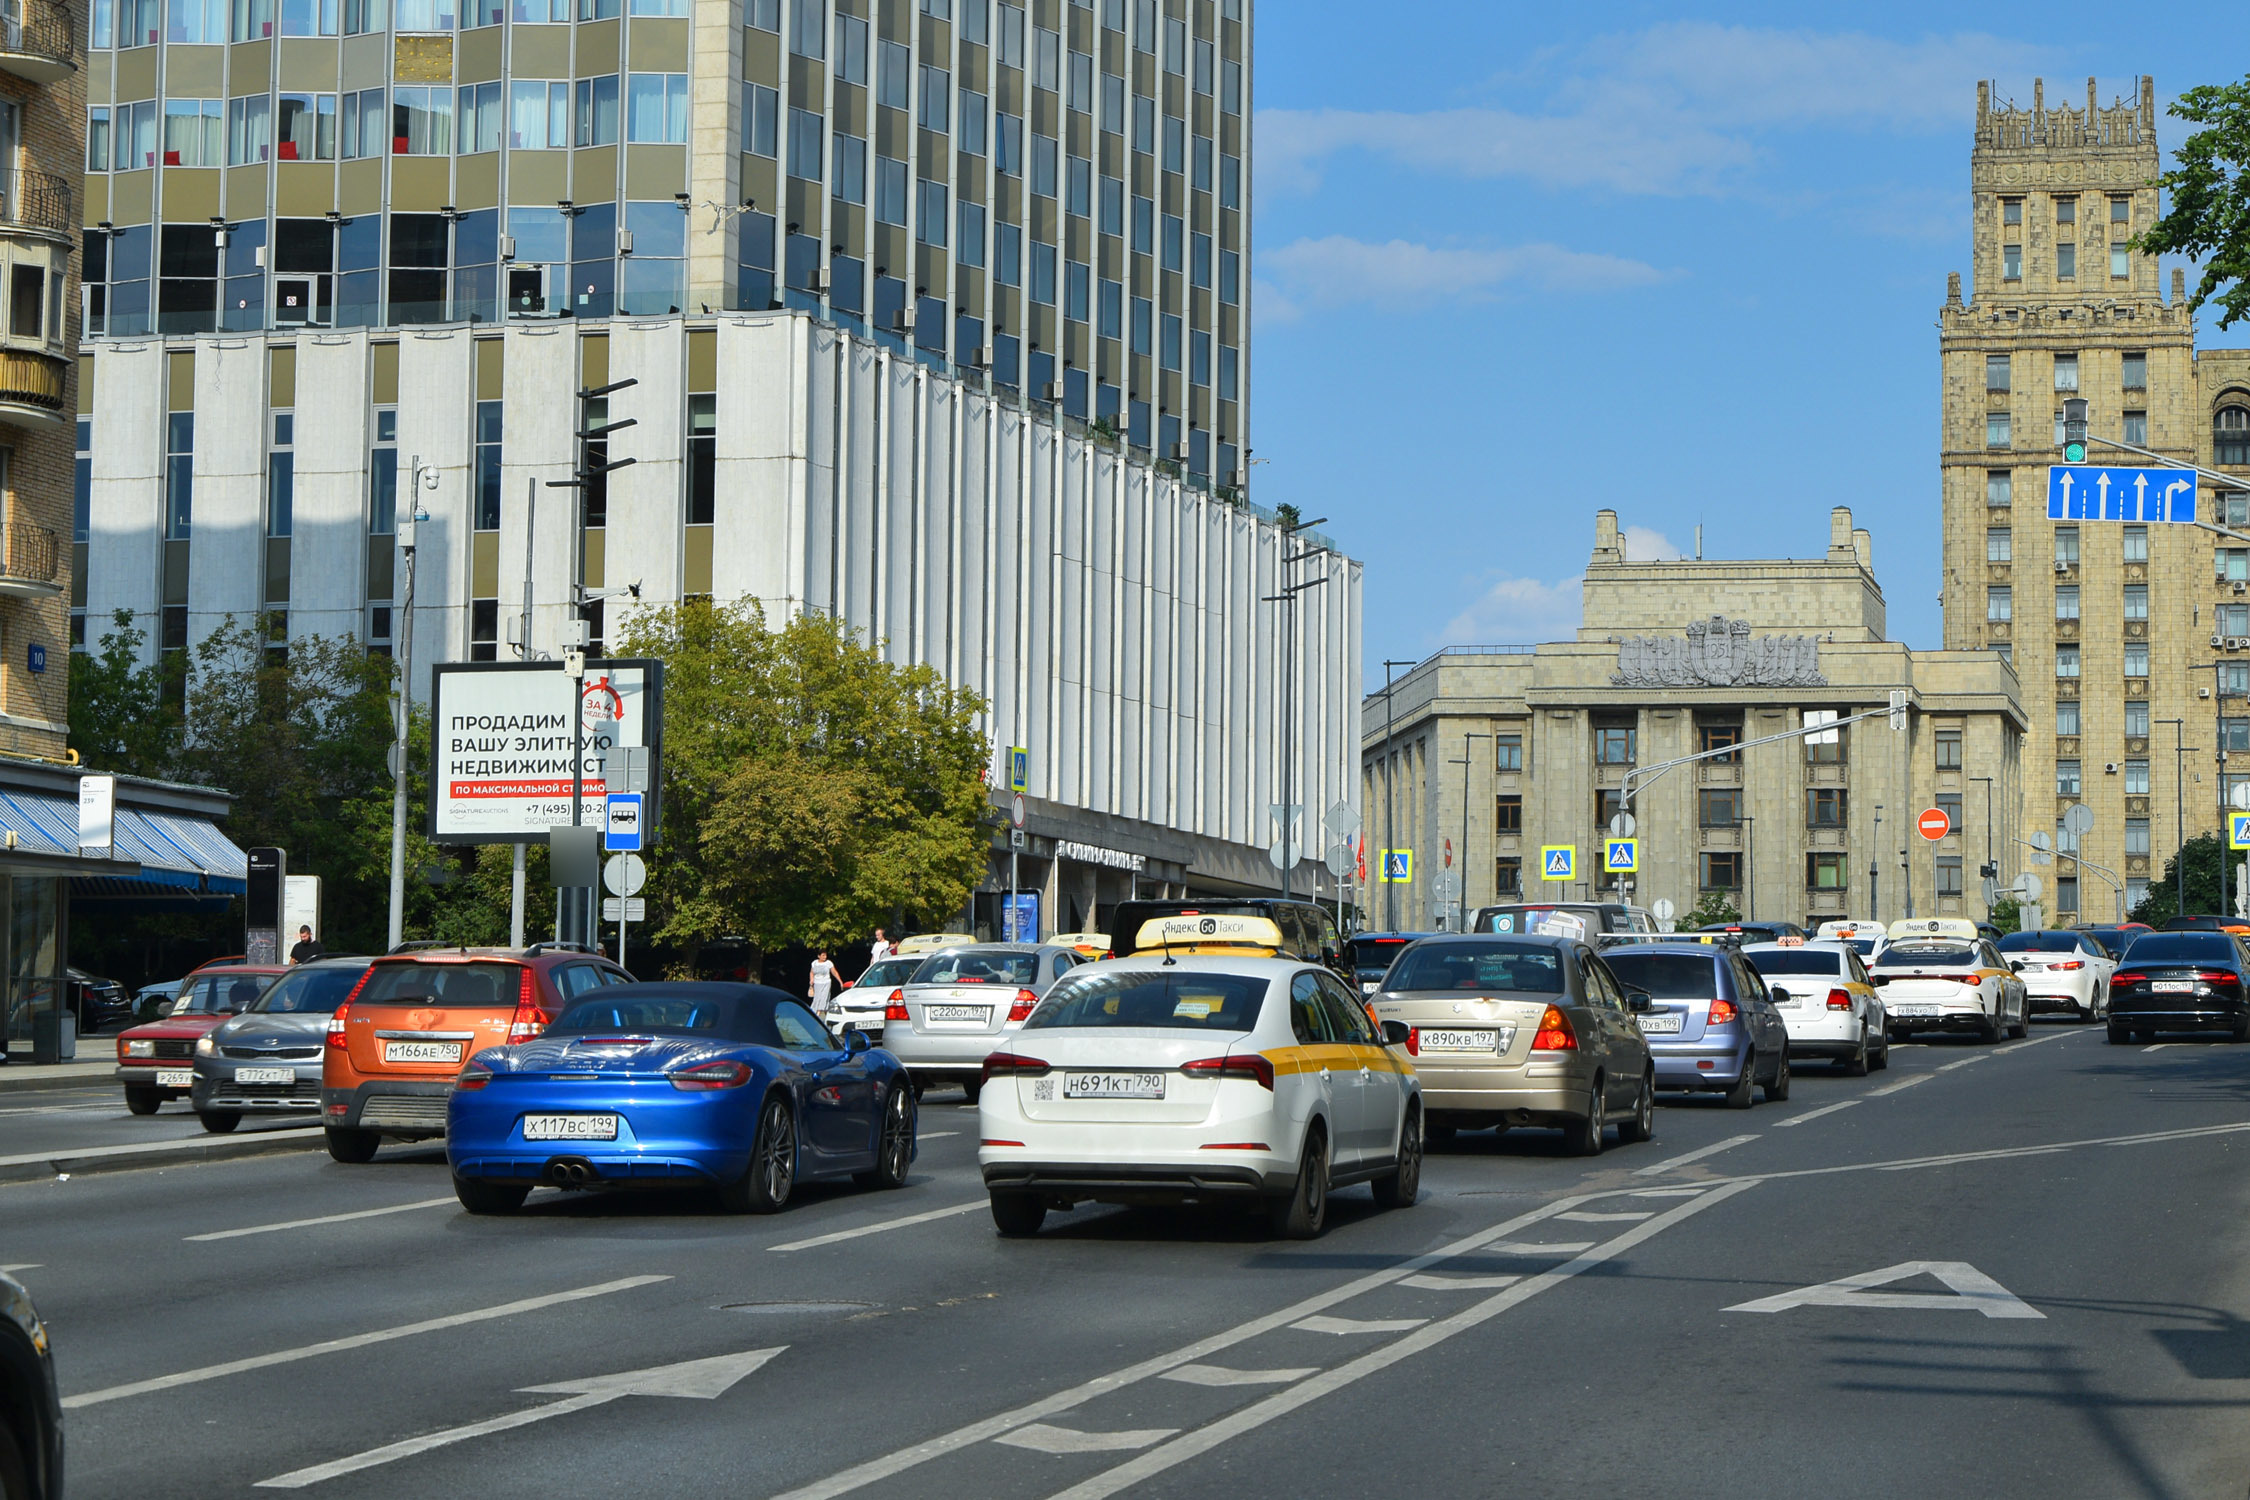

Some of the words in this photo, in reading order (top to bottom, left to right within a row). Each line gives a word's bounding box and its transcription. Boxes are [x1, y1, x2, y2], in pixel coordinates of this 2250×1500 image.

[1705, 643, 1730, 658] 1951
[34, 652, 44, 665] 10
[586, 699, 601, 710] ЗА
[604, 703, 612, 712] 4
[584, 710, 611, 719] НЕДЕЛИ
[452, 714, 566, 732] ПРОДАДИМ
[451, 737, 509, 753] ВАШУ
[451, 758, 607, 777] НЕДВИЖИМСТ
[455, 786, 471, 794] ПО
[473, 783, 560, 794] МАКСИМАЛЬНОЙ
[526, 805, 539, 813] +7
[542, 804, 571, 816] (495)
[1164, 921, 1197, 934] Яндекс
[1200, 920, 1216, 934] Go
[1219, 921, 1244, 933] Такси
[1424, 1033, 1472, 1045] К890КВ
[1475, 1033, 1493, 1042] 197
[389, 1044, 438, 1058] М166АЕ
[440, 1045, 458, 1055] 750
[1070, 1075, 1132, 1091] Н691КТ
[1136, 1075, 1160, 1087] 790
[529, 1117, 586, 1133] Х117ВС
[590, 1117, 612, 1127] 199
